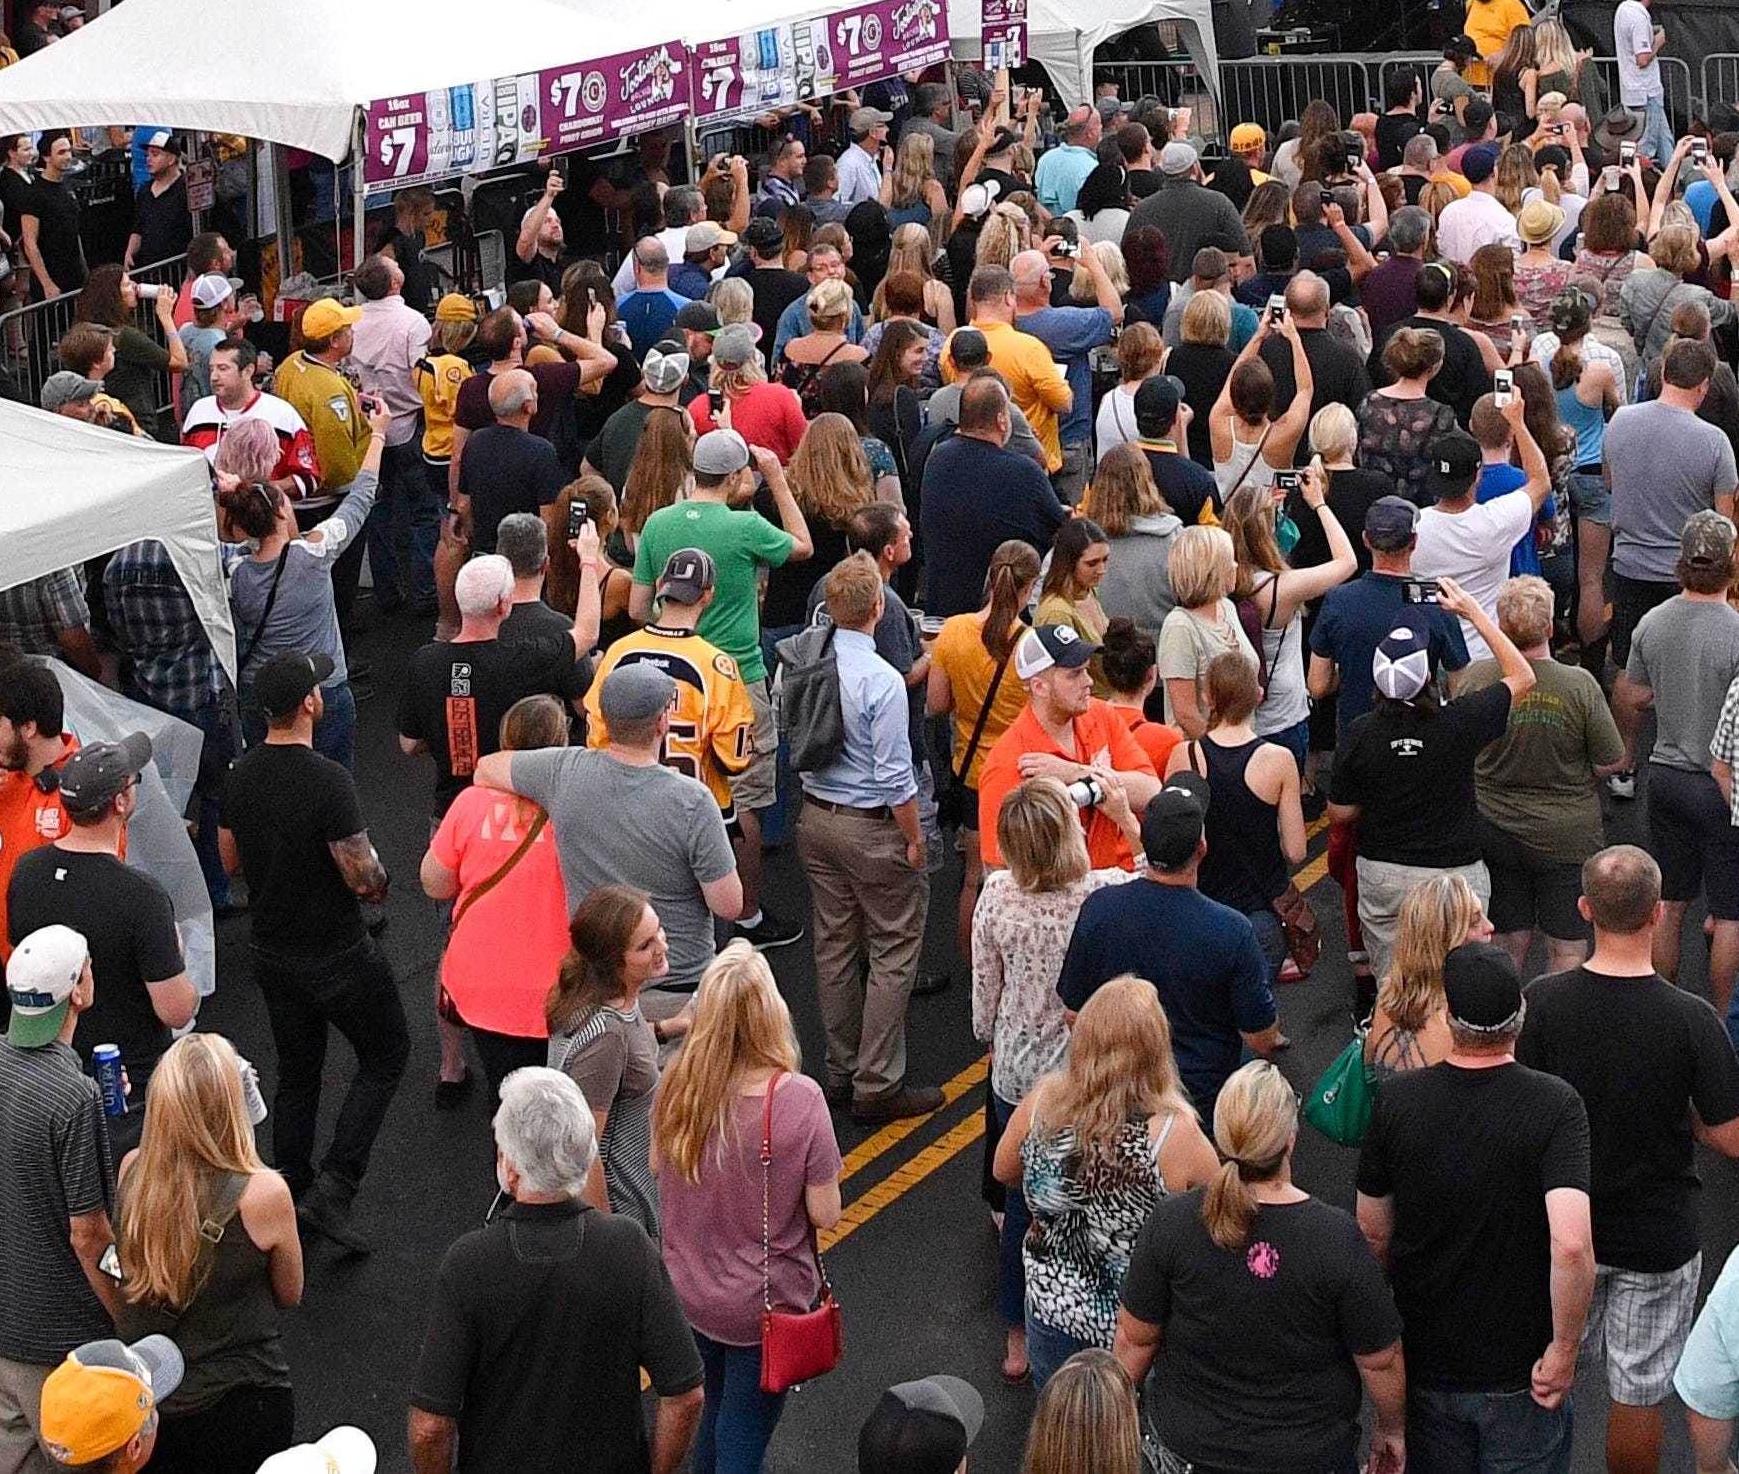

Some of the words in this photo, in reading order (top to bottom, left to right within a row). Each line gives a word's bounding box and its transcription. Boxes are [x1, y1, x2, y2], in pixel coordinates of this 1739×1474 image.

[837, 15, 862, 55] $7
[550, 71, 582, 118] $7
[701, 66, 736, 112] $7
[378, 116, 397, 130] CAN
[397, 112, 423, 126] BEER
[380, 126, 416, 177] $7
[451, 678, 471, 696] 53
